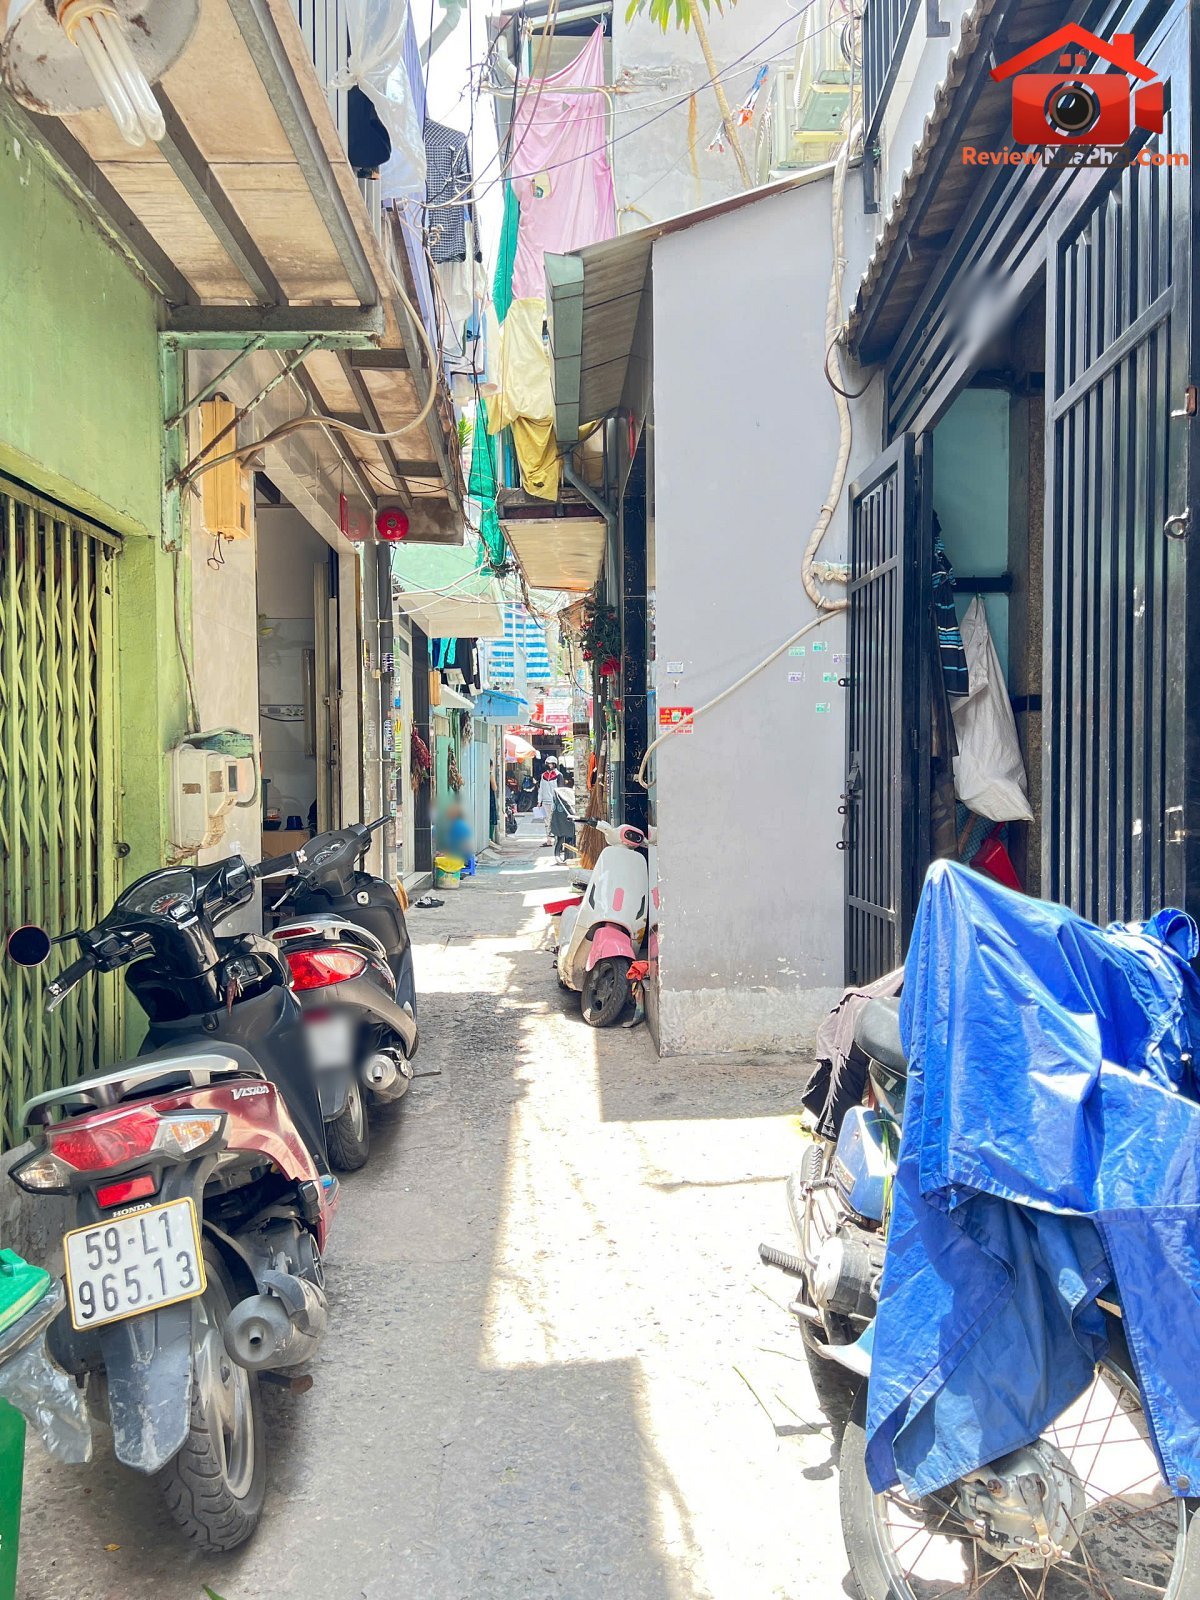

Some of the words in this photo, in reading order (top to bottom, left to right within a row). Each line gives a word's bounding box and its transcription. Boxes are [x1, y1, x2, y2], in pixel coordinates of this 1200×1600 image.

[112, 1202, 153, 1218] HONDA
[85, 1211, 174, 1271] 59-L1
[78, 1251, 196, 1320] 965.13
